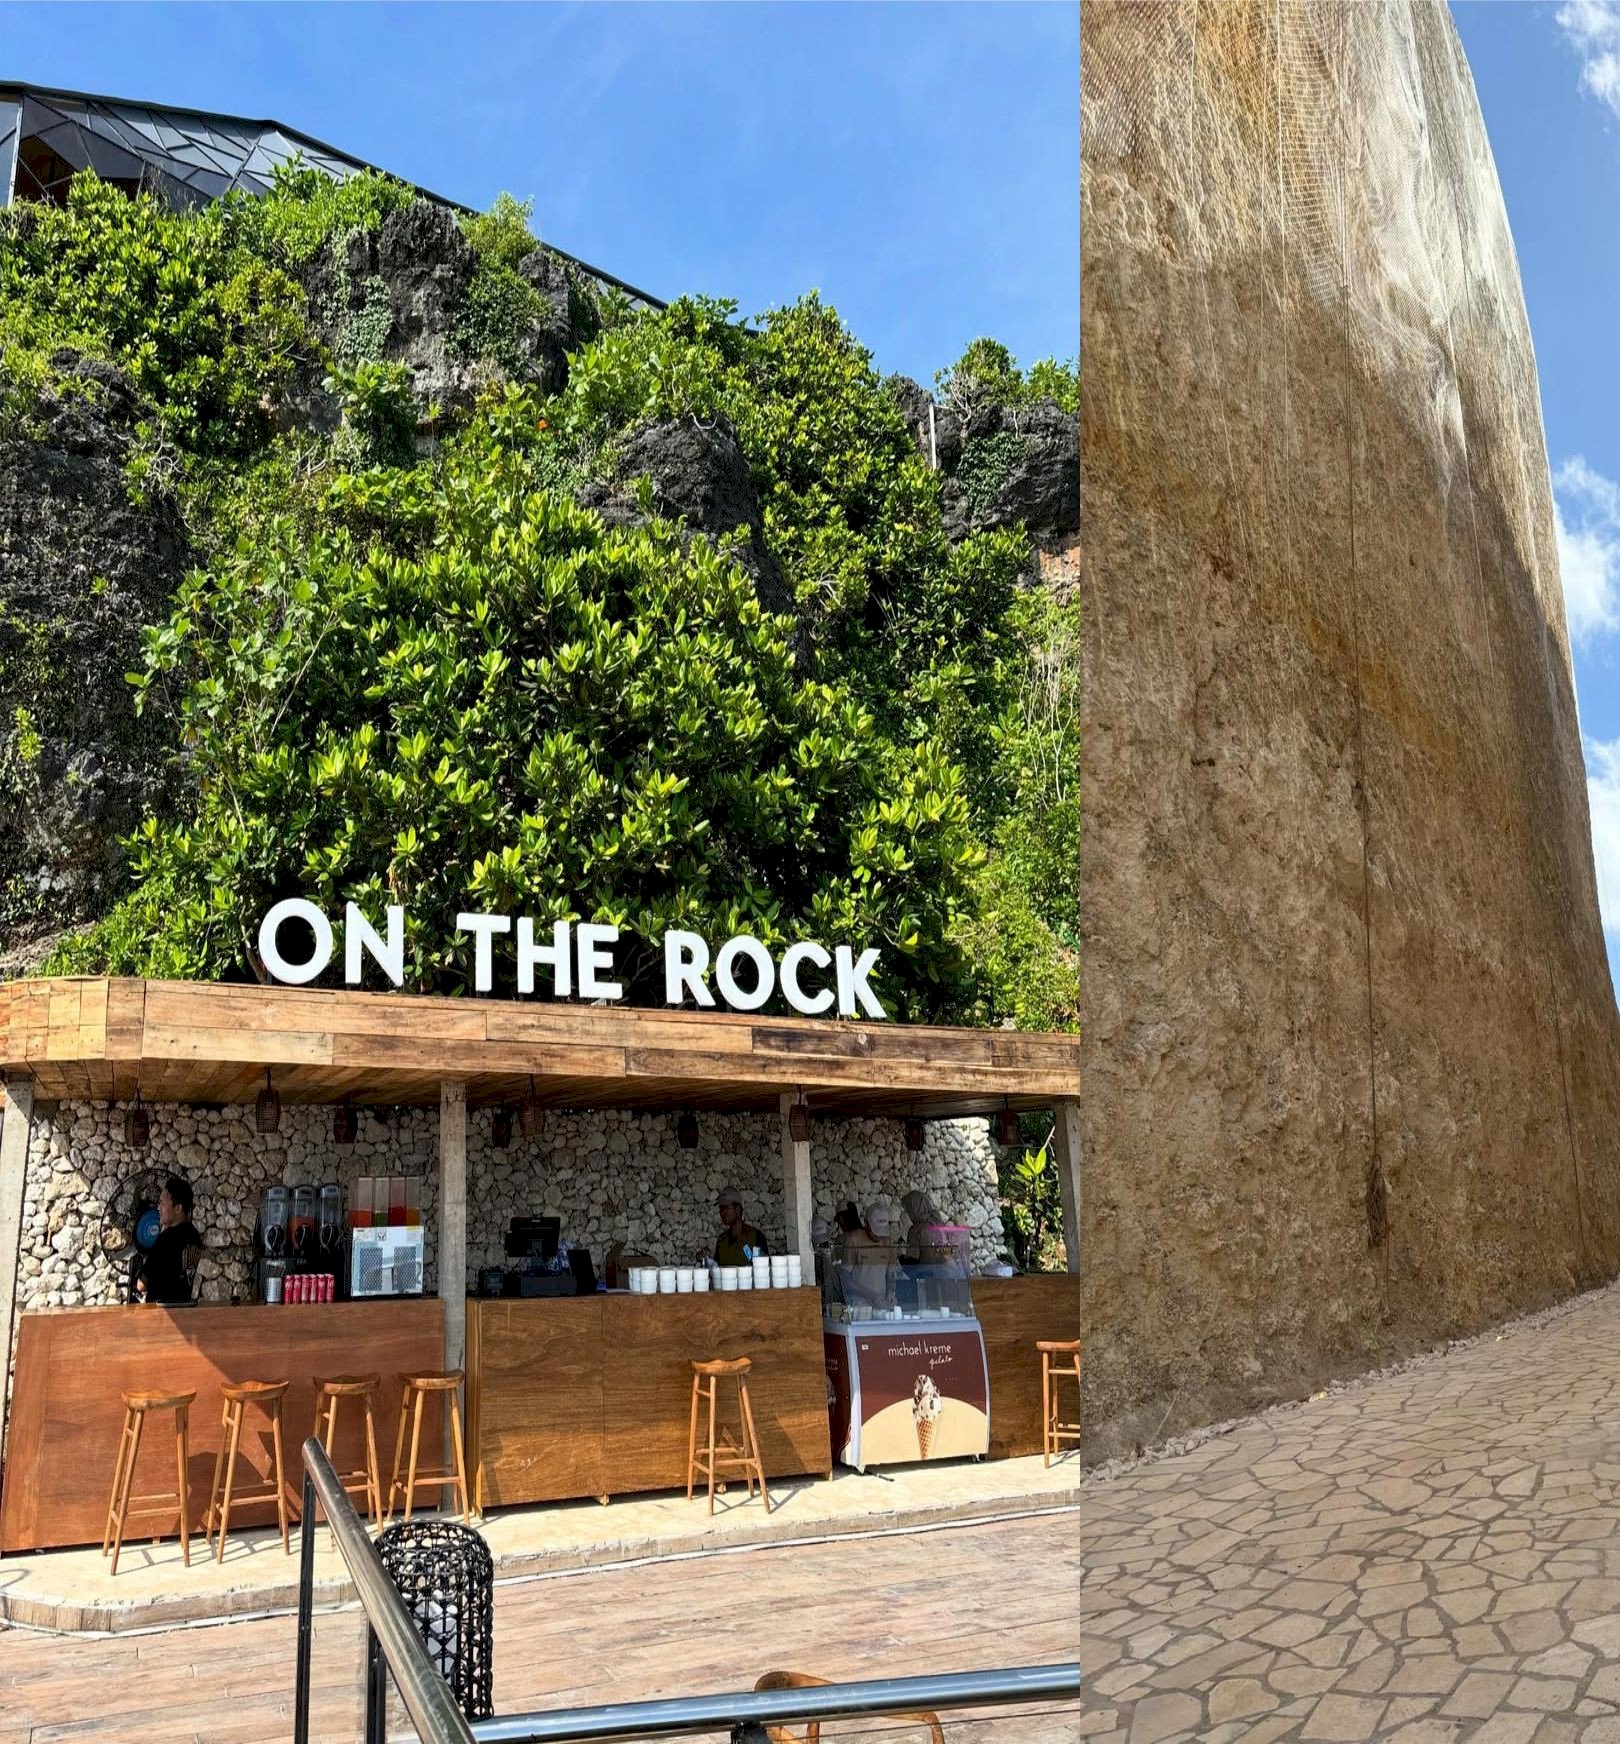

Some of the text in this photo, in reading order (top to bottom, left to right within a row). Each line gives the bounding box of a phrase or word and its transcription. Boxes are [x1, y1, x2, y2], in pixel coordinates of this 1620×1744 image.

[258, 898, 887, 1018] ON THE ROCK
[888, 1339, 952, 1357] michael kreme
[929, 1355, 953, 1370] gelato
